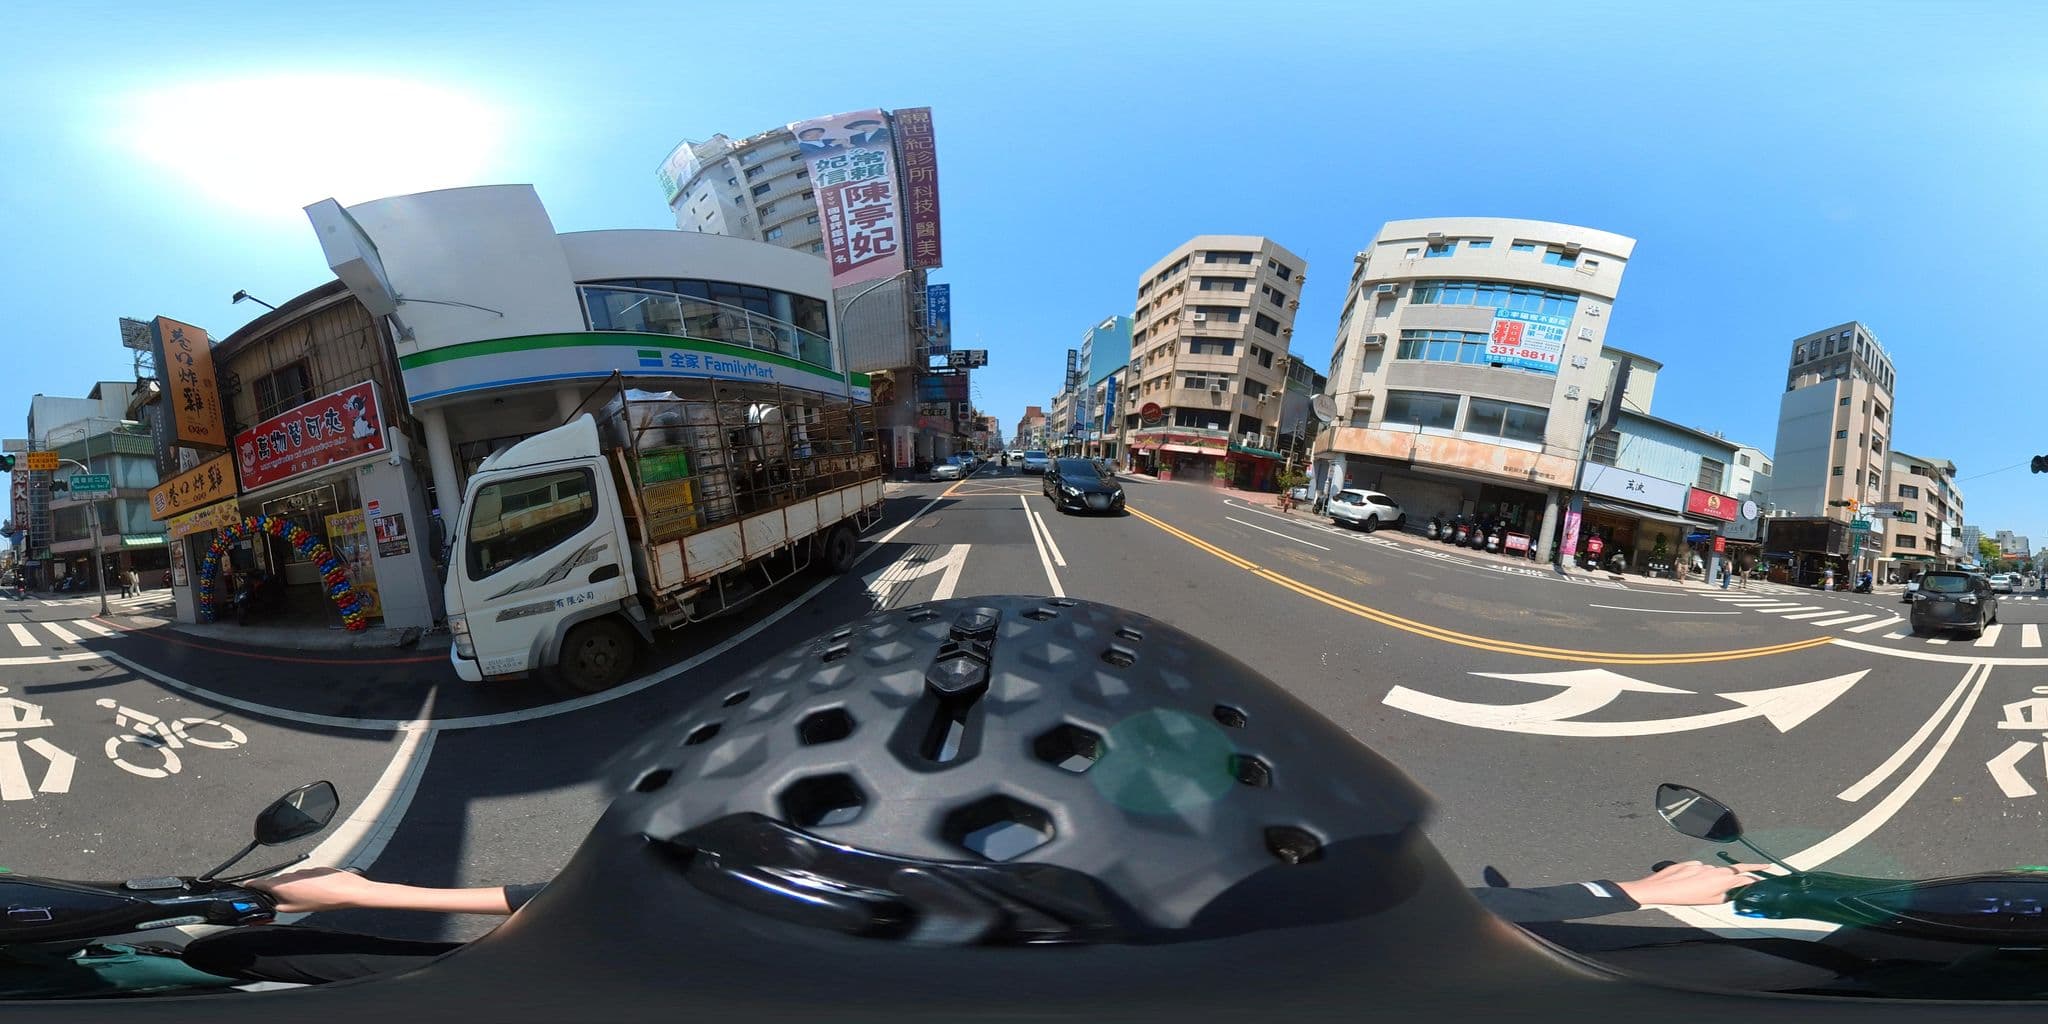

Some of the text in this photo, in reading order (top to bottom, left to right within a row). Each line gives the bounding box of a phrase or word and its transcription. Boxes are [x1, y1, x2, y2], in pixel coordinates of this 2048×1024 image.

[816, 151, 885, 170] 妃常
[816, 163, 885, 185] 信賴
[845, 181, 898, 259] 陳亭妃
[1493, 320, 1524, 346] 租
[669, 352, 775, 379] 全家 FamilyMart
[1490, 345, 1556, 362] 331-8811
[257, 407, 345, 461] 萬物皆可夾
[555, 591, 594, 608] 有限公司
